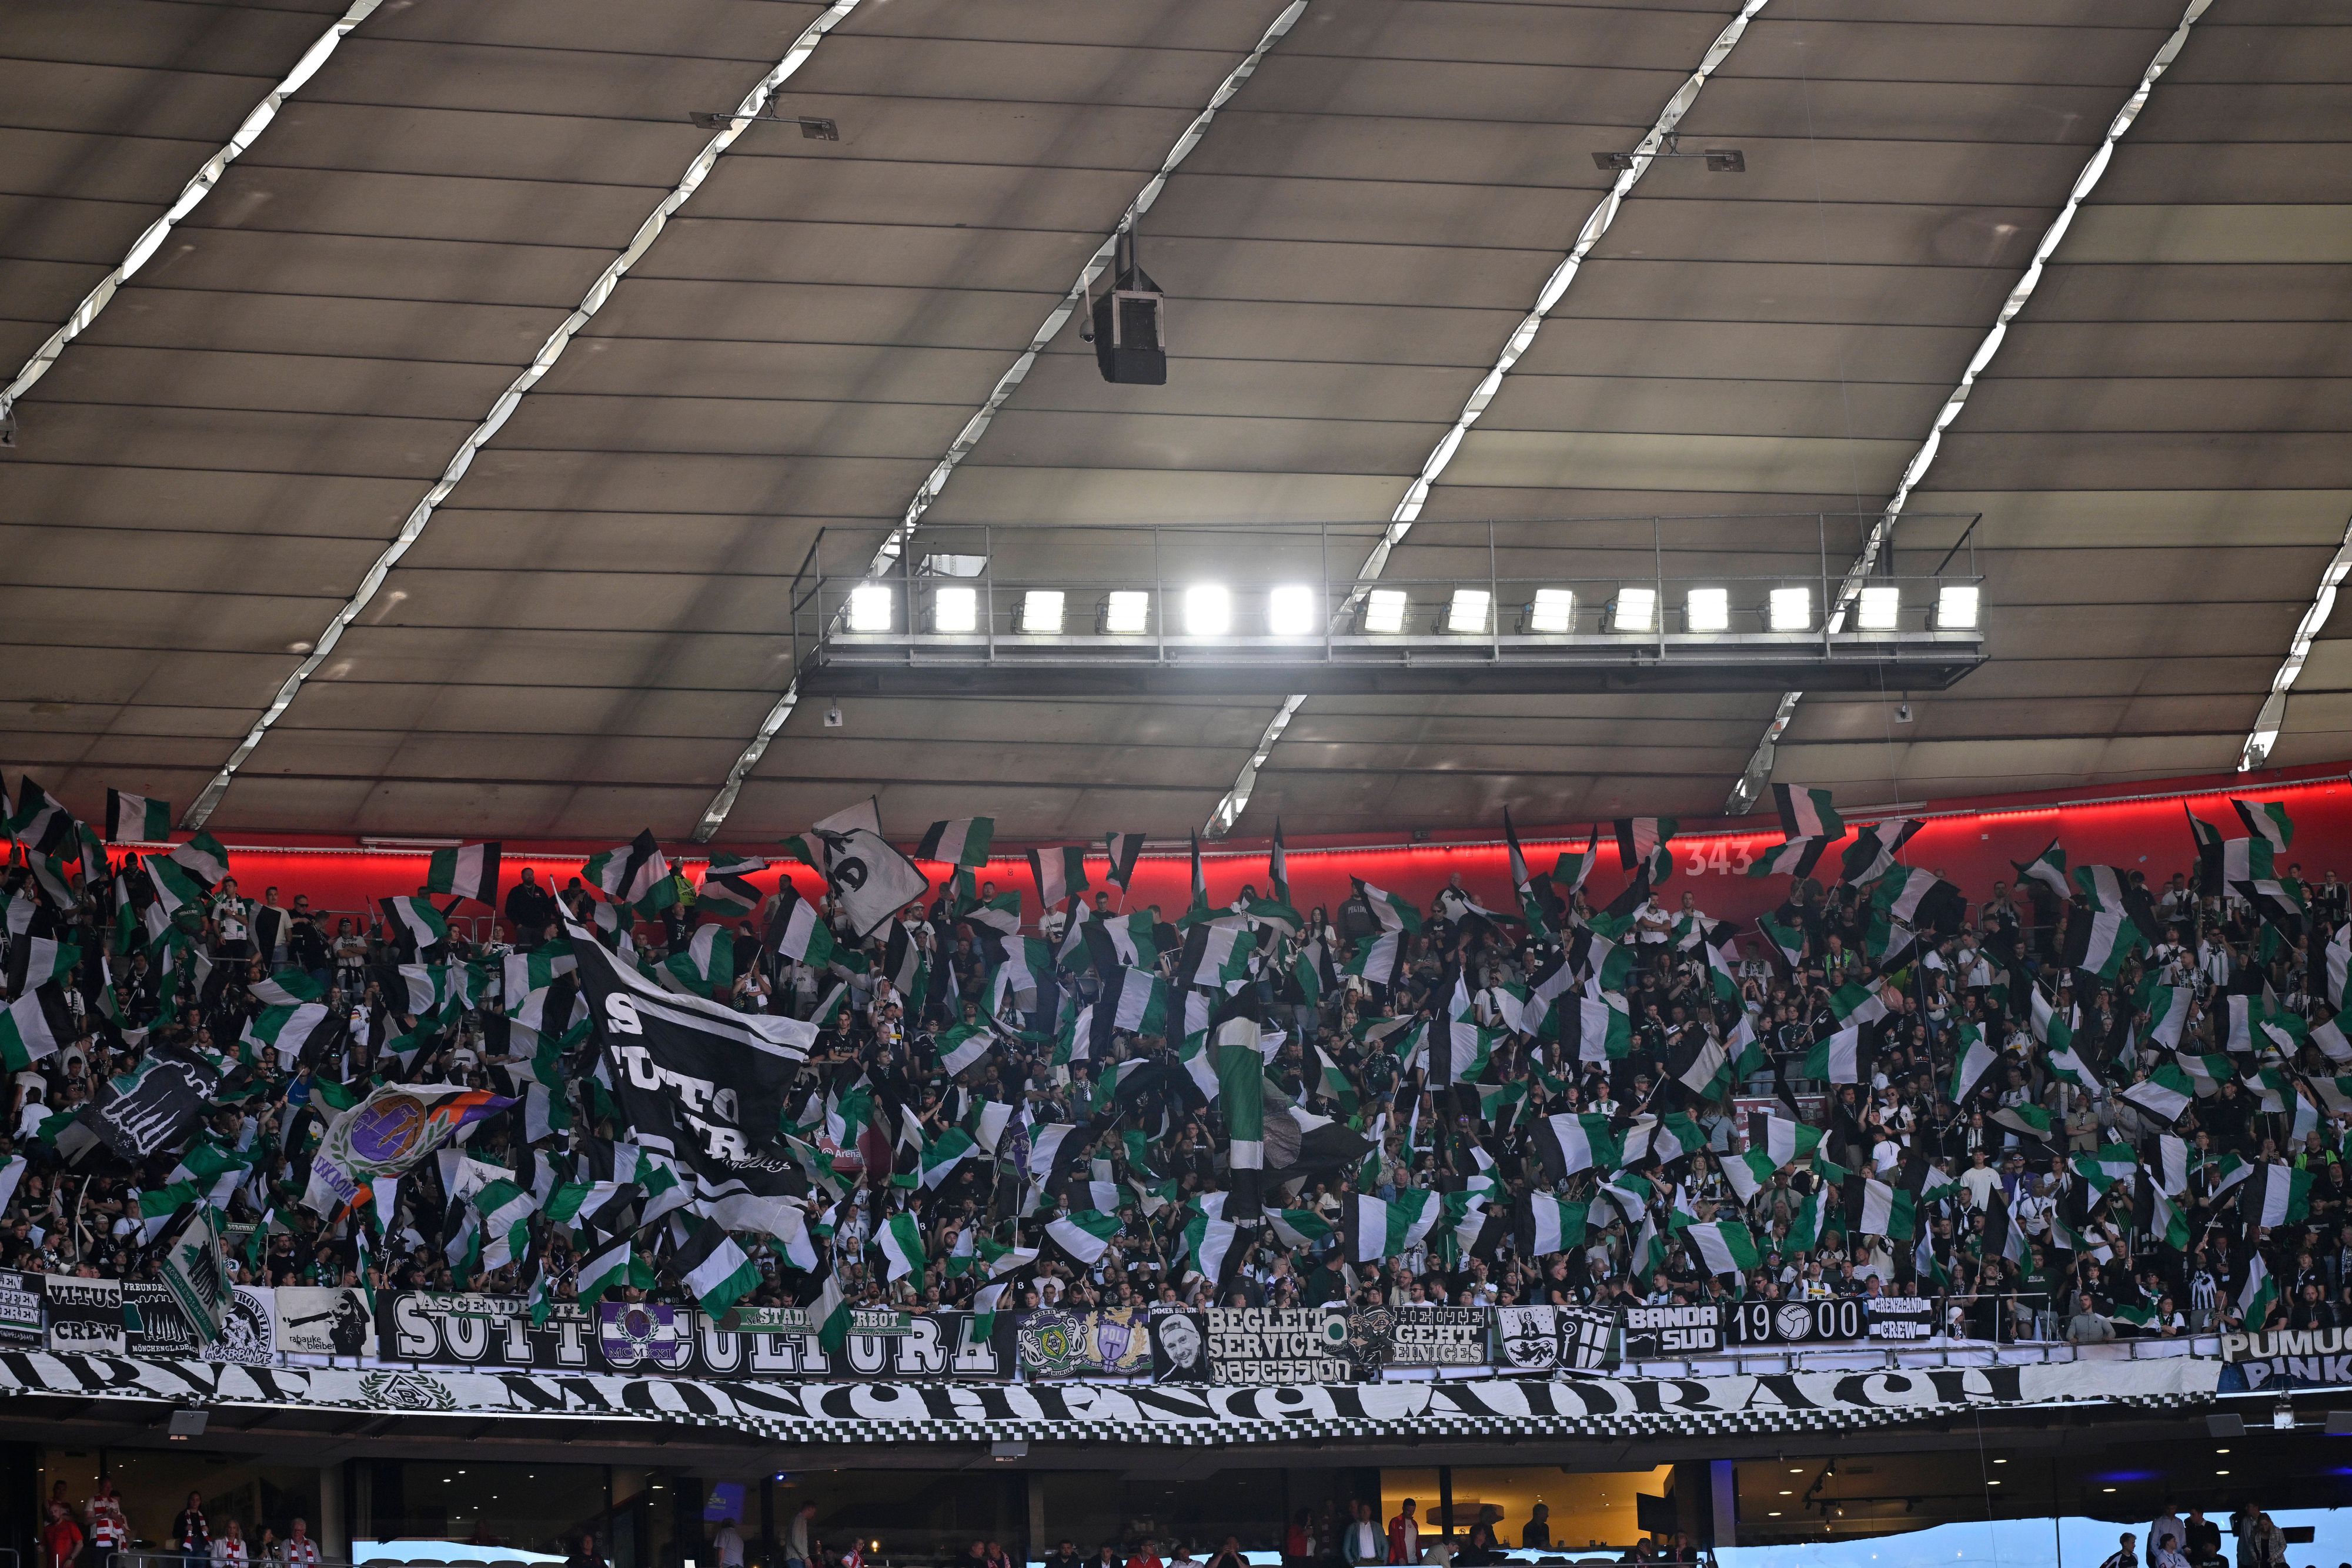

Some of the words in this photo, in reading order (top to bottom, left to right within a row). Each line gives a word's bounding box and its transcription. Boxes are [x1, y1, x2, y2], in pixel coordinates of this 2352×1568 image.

[1685, 841, 1753, 876] 343
[835, 1150, 861, 1159] Arena
[0, 1272, 22, 1290] EN
[1148, 1282, 1155, 1290] B
[48, 1285, 122, 1309] VITUS
[1874, 1297, 1923, 1314] GRENZLAND
[0, 1305, 39, 1323] EREN
[1034, 1309, 1055, 1319] NORD
[1151, 1307, 1174, 1315] IMMER
[1205, 1308, 1327, 1334] BEGLEIT
[1394, 1306, 1485, 1328] HEUTE
[1627, 1306, 1718, 1329] BANDA
[1732, 1303, 1769, 1341] 19
[1818, 1300, 1857, 1338] 00
[54, 1321, 121, 1342] CREW
[1100, 1327, 1128, 1345] POLI
[1396, 1325, 1477, 1345] GEHT
[1662, 1328, 1717, 1350] SUD
[1880, 1320, 1917, 1339] CREW
[132, 1343, 199, 1355] MÖNCHENGLADBACH
[289, 1335, 321, 1345] rabauke
[1208, 1332, 1322, 1359] SERVICE
[206, 1342, 273, 1365] ACKERBANDE
[608, 1347, 671, 1359] MCMXXI
[1393, 1343, 1484, 1364] EINIGES
[1114, 1365, 1141, 1374] TIMISOARA
[1213, 1359, 1351, 1383] OBSESSION
[2242, 1355, 2352, 1390] PINK
